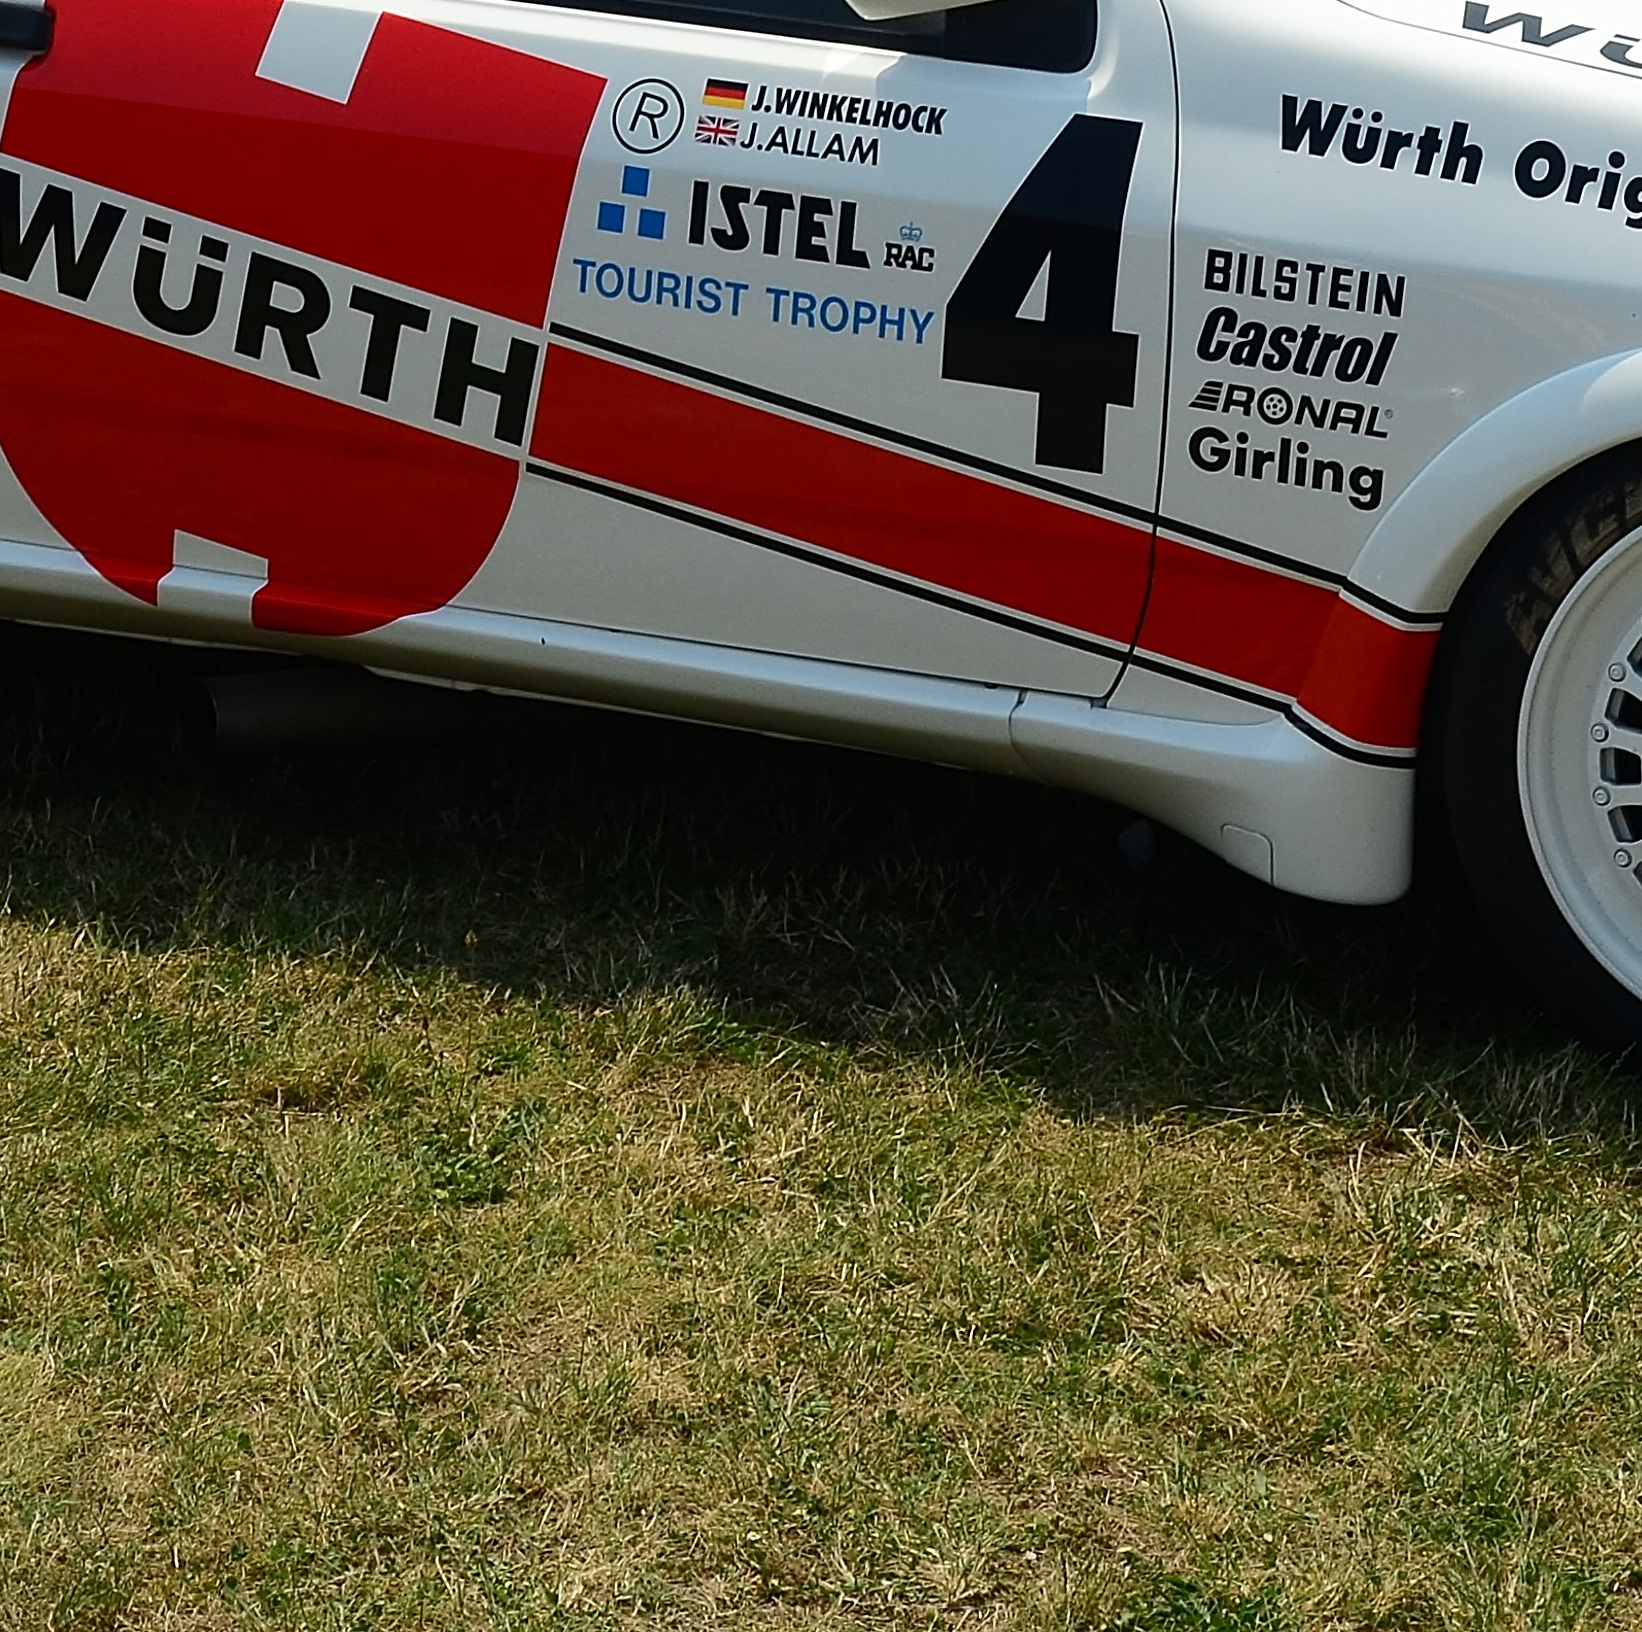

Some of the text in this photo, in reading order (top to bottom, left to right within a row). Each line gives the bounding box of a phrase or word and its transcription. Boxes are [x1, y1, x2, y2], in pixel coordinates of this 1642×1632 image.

[739, 122, 881, 167] J.ALLAM
[751, 84, 948, 137] J.WINKELHOCK
[1280, 94, 1485, 186] Würth
[688, 179, 935, 273] ISTEL RAC
[572, 258, 935, 345] TOURIST TROPHY
[941, 112, 1144, 476] 4
[1203, 248, 1407, 318] BILSTEIN
[1195, 306, 1399, 387] Castrol
[1219, 379, 1390, 439] RONAL
[1187, 426, 1385, 513] Girling
